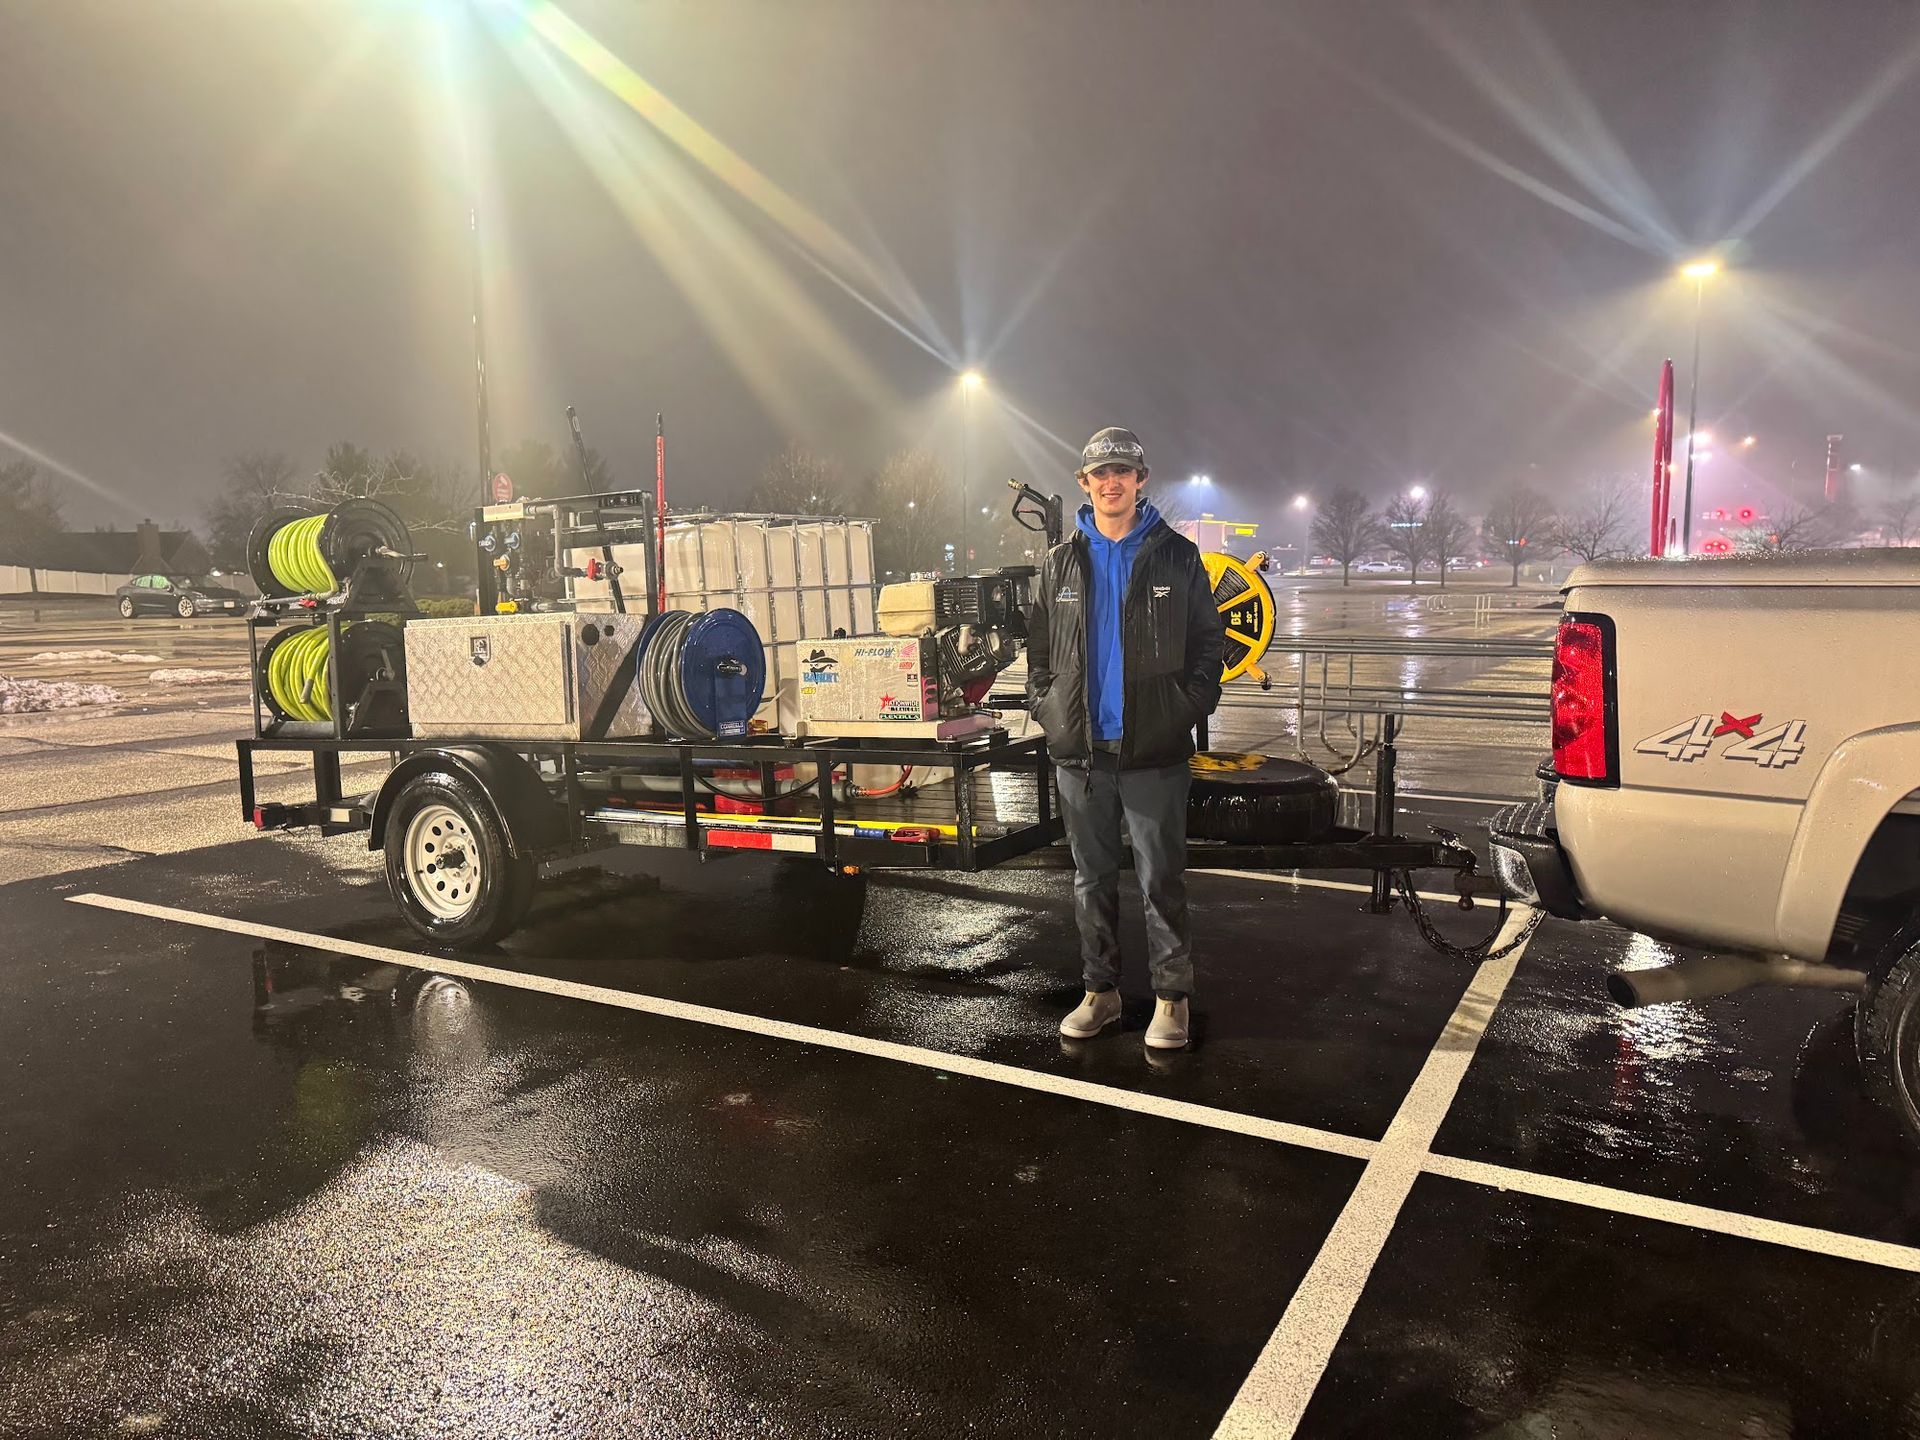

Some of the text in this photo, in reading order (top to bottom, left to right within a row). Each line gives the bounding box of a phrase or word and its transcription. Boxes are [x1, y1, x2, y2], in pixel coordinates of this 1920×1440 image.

[1230, 611, 1242, 626] BE
[855, 648, 895, 657] HI-FLOW
[803, 671, 840, 683] BANDIT
